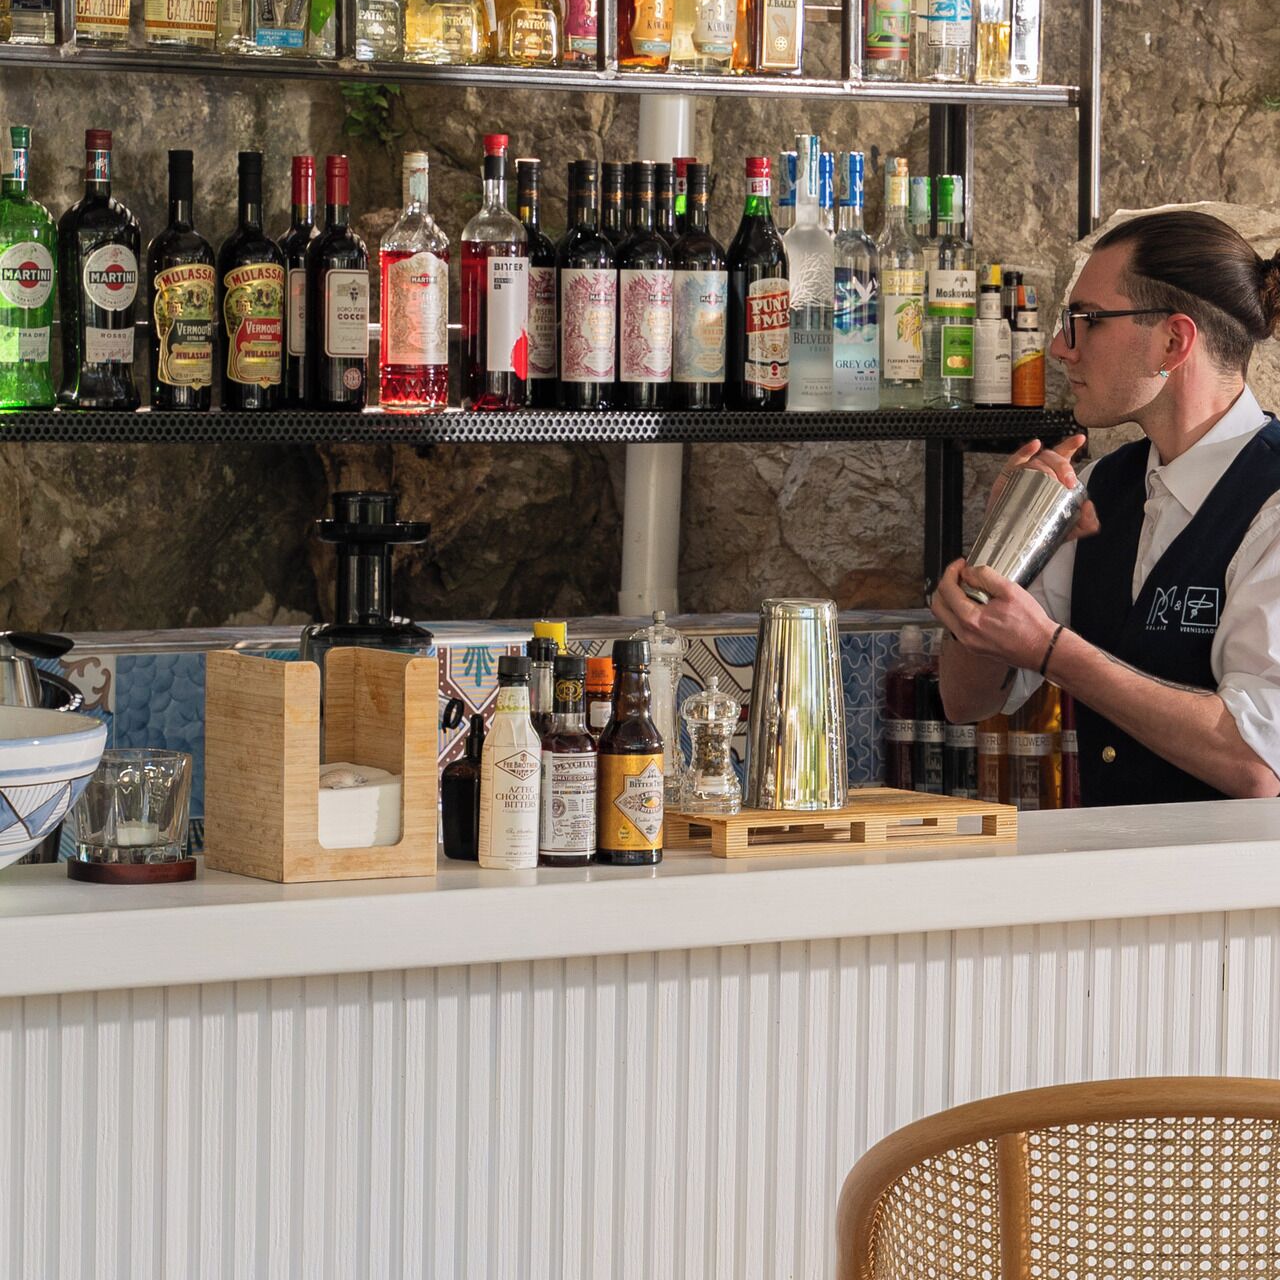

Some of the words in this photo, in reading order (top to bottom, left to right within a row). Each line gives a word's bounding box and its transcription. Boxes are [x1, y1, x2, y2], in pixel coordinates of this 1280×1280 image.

[359, 9, 395, 21] PATRÓN
[517, 17, 551, 31] PATRÓN
[494, 262, 523, 271] BITTER
[3, 269, 50, 280] MARTINI
[90, 271, 136, 283] MARTINI
[752, 296, 788, 314] PUNT
[176, 322, 212, 336] VERMOUTH
[246, 321, 281, 335] VERMOUTH
[835, 359, 860, 369] GREY
[503, 761, 513, 769] FEE
[508, 785, 535, 794] AZTEC
[504, 800, 537, 809] BITTERS
